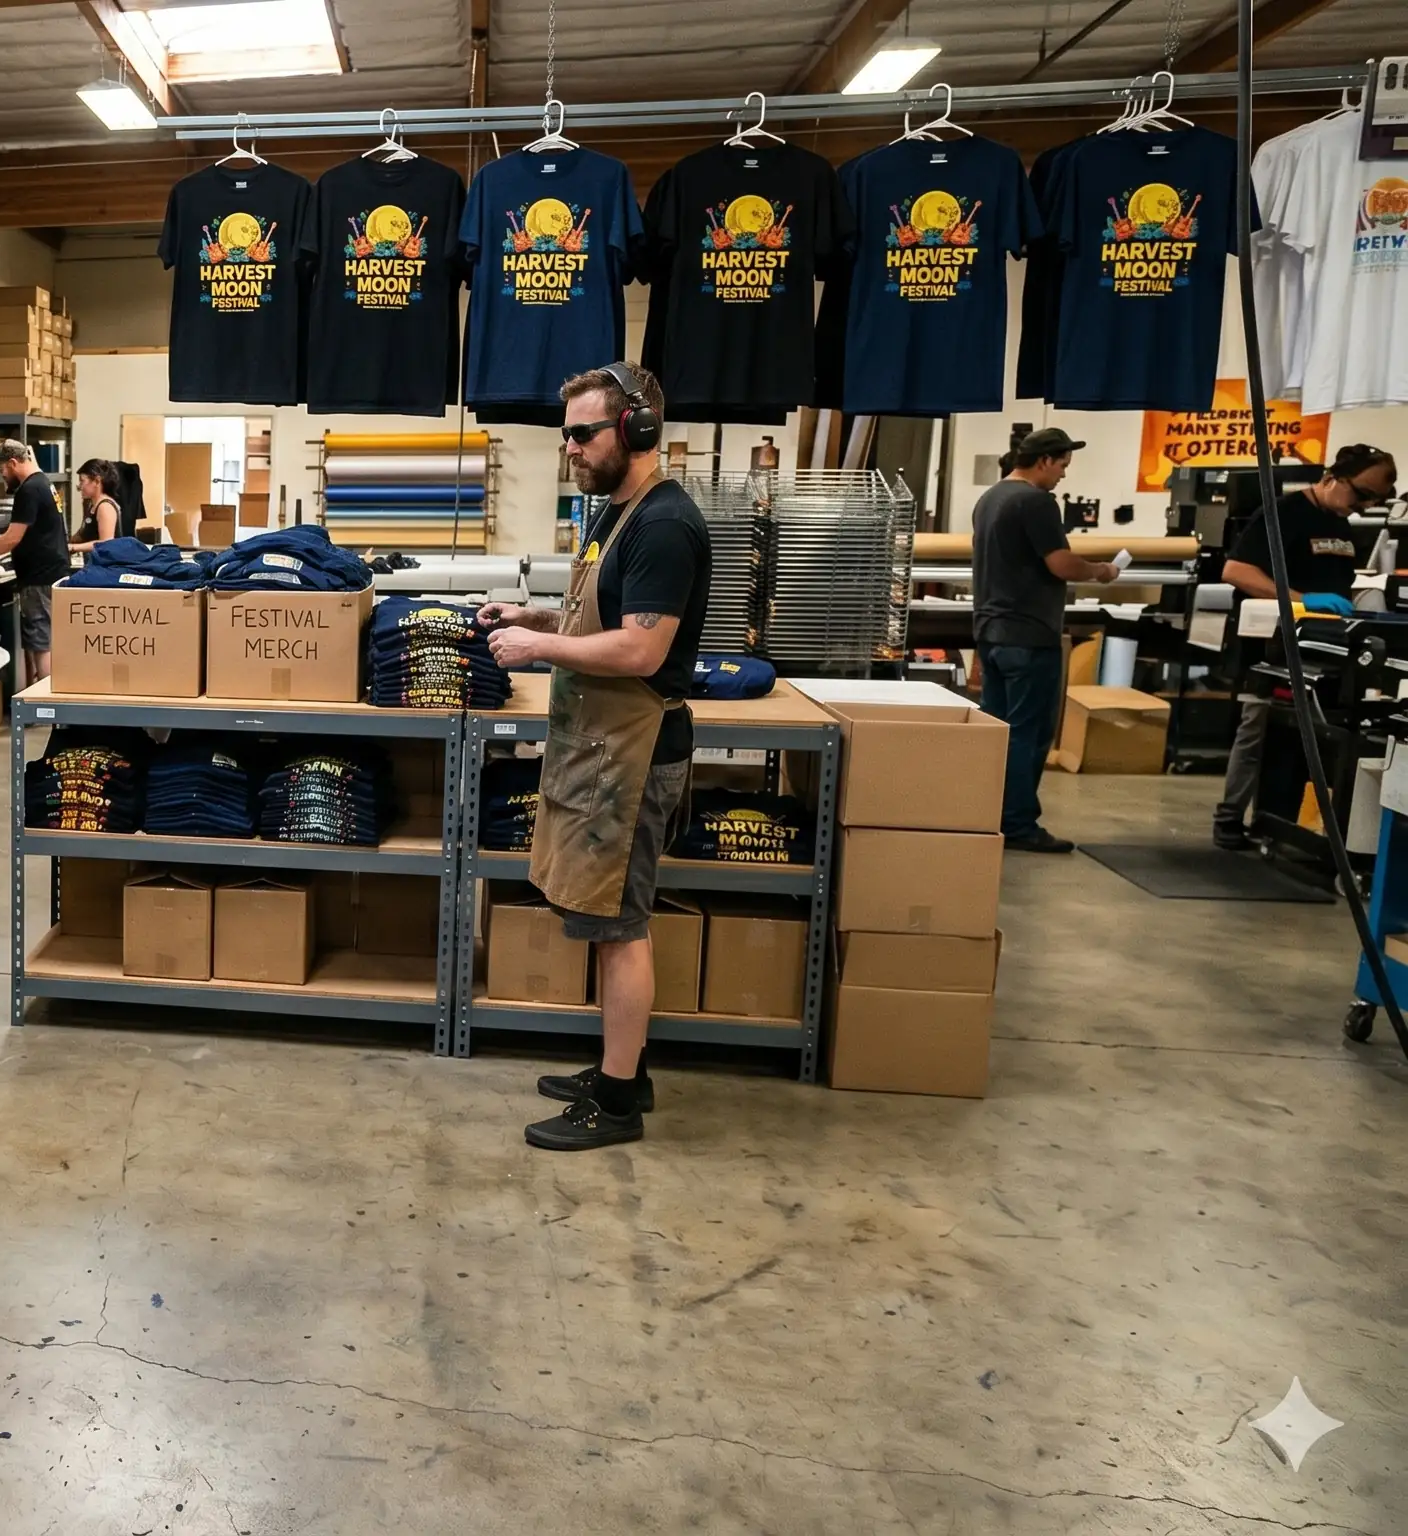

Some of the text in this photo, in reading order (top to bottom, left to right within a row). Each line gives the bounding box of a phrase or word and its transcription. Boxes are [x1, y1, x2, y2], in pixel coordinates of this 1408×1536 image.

[702, 251, 789, 268] HARVEST
[887, 248, 978, 267] HARVEST
[1101, 242, 1197, 261] HARVEST
[345, 259, 426, 276] HARVEST
[503, 253, 588, 271] HARVEST
[1114, 261, 1177, 278] MOON
[200, 264, 276, 280] HARVEST
[515, 271, 571, 288] MOON
[715, 269, 773, 286] MOON
[900, 266, 959, 283] MOON
[211, 281, 262, 297] MOON
[357, 276, 411, 293] MOON
[716, 287, 771, 298] FESTIVAL
[900, 284, 956, 297] FESTIVAL
[1114, 280, 1173, 292] FESTIVAL
[357, 293, 409, 305] FESTIVAL
[515, 289, 570, 301] FESTIVAL
[69, 602, 171, 626] FESTIVAL
[231, 605, 330, 629] FESTIVAL
[84, 634, 155, 656] MERCH
[244, 637, 318, 660] MERCH
[704, 820, 800, 840] HARVEST
